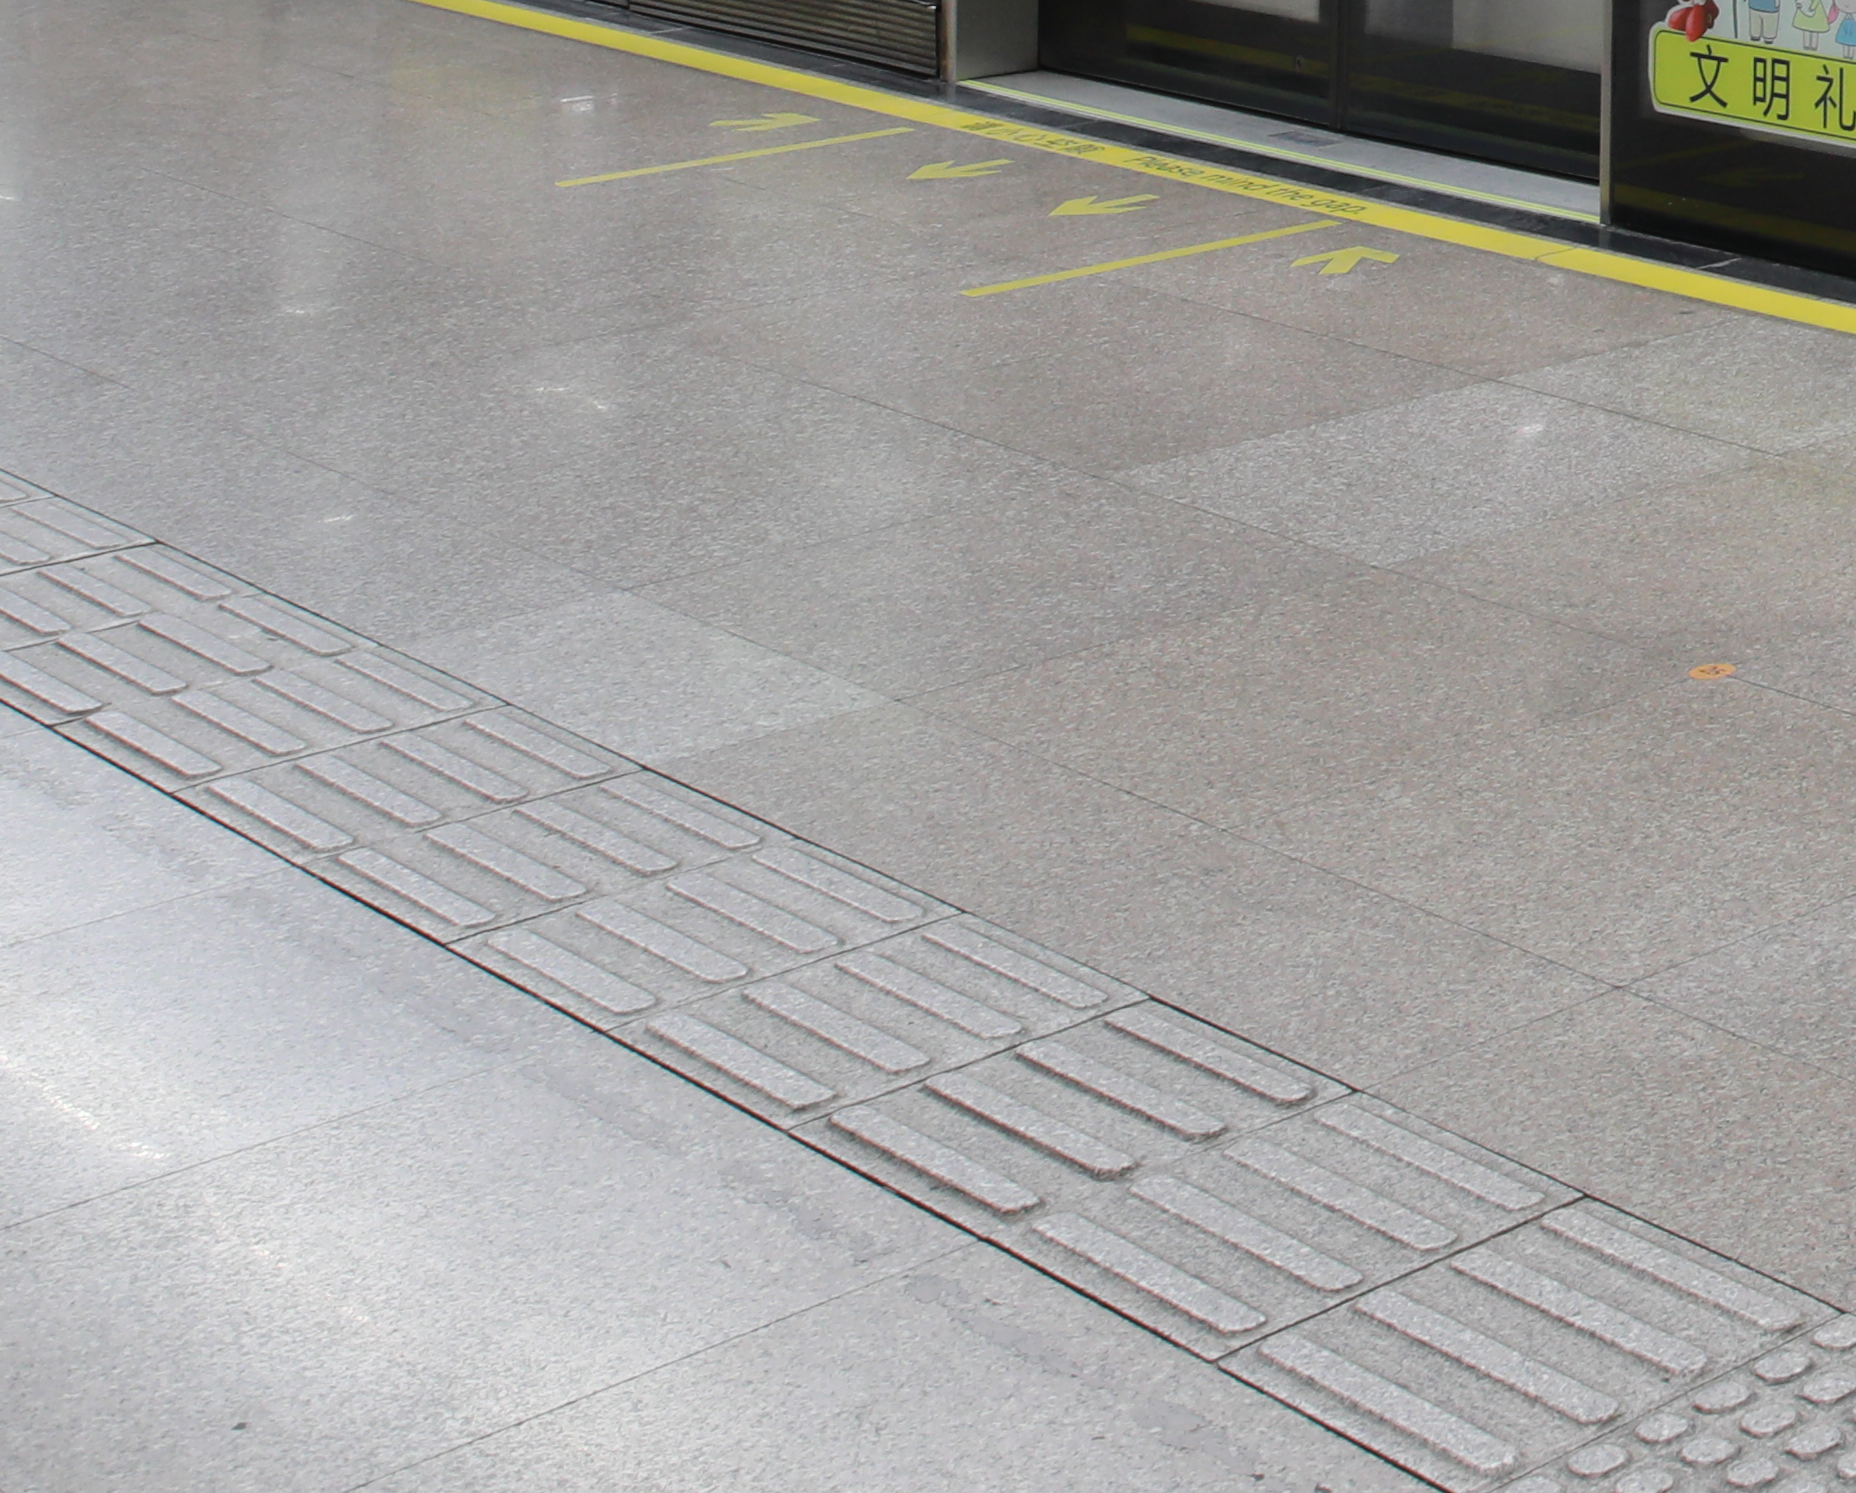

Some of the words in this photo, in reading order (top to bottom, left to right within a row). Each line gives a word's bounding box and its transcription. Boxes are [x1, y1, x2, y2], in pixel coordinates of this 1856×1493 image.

[1123, 155, 1205, 179] Please
[1204, 174, 1264, 194] mind
[1265, 183, 1304, 202] the
